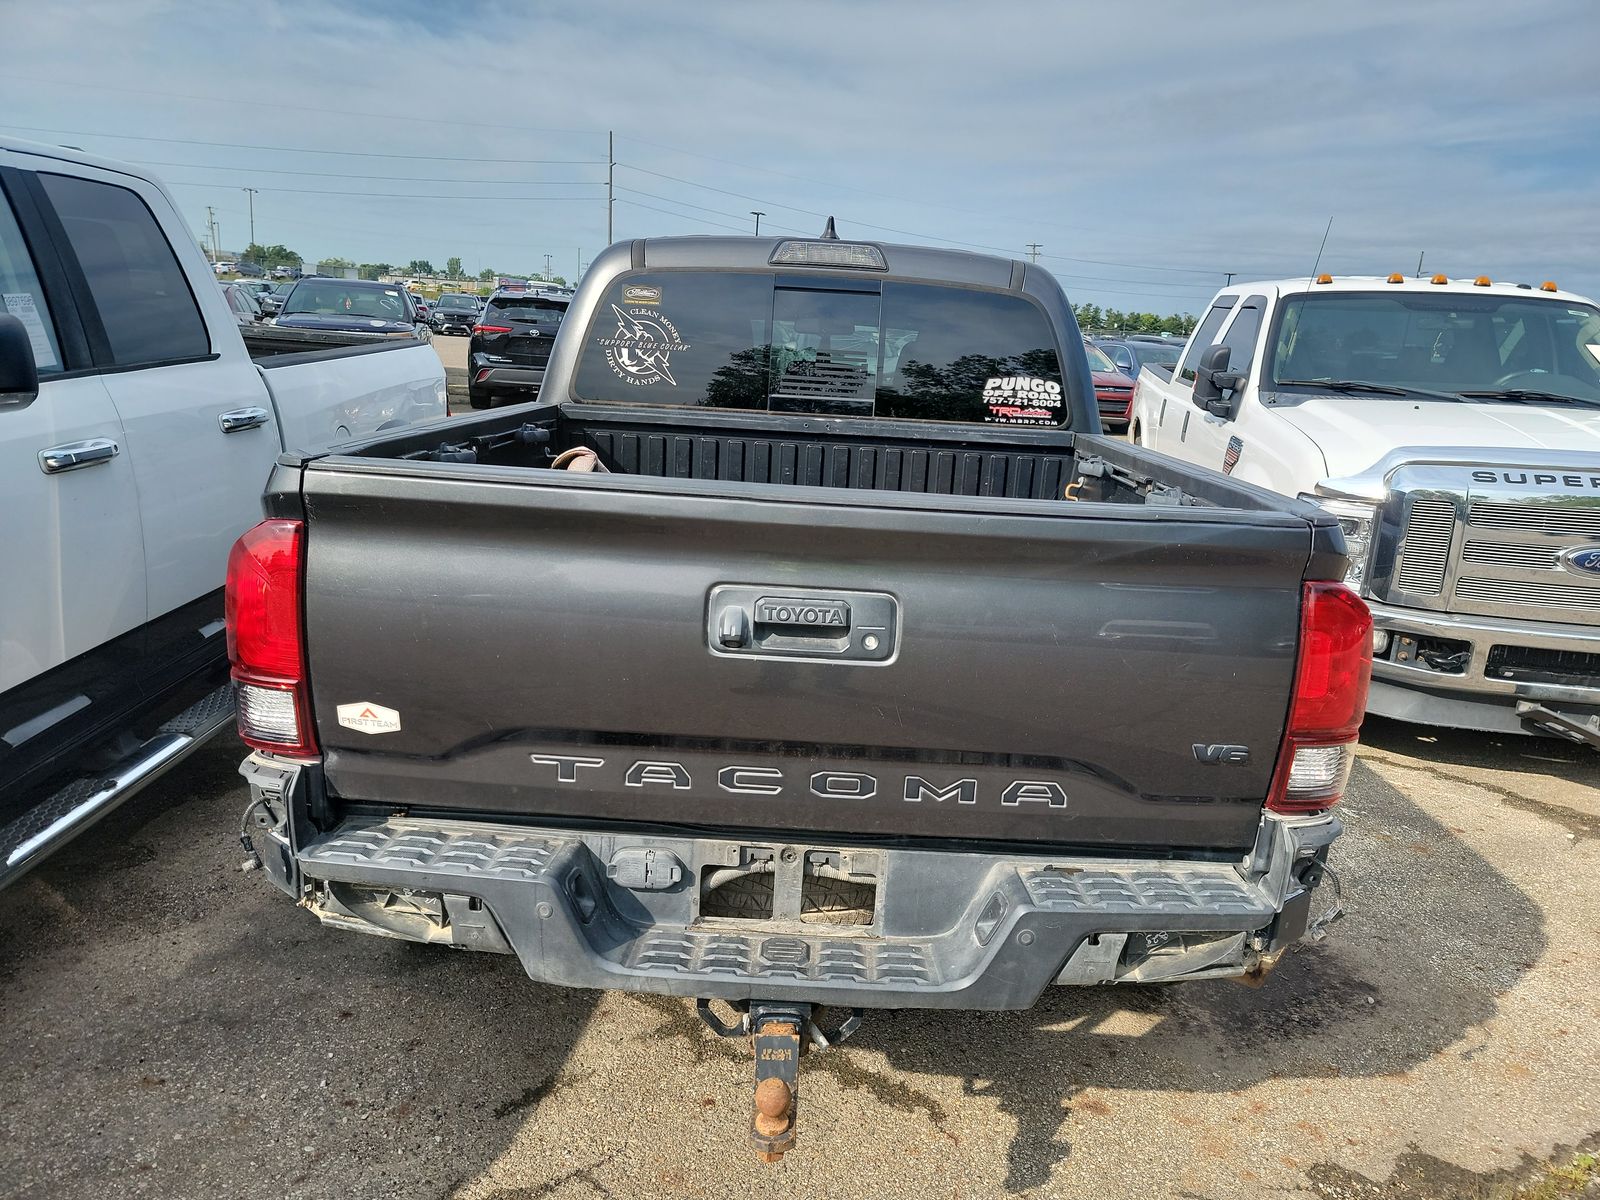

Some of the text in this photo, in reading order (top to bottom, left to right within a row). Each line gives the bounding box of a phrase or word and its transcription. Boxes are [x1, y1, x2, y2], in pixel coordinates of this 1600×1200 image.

[630, 309, 682, 344] CLEAN MONEY
[605, 349, 661, 386] DIRTY HANDS
[985, 377, 1061, 393] PUNGO
[983, 397, 1061, 407] 757-721-6004
[1017, 391, 1062, 400] ROAD
[989, 406, 1021, 417] TRD
[764, 606, 844, 625] TOYOTA
[341, 717, 398, 728] FIRST TEAM
[1191, 743, 1249, 767] V6
[530, 754, 1067, 809] TACOMA
